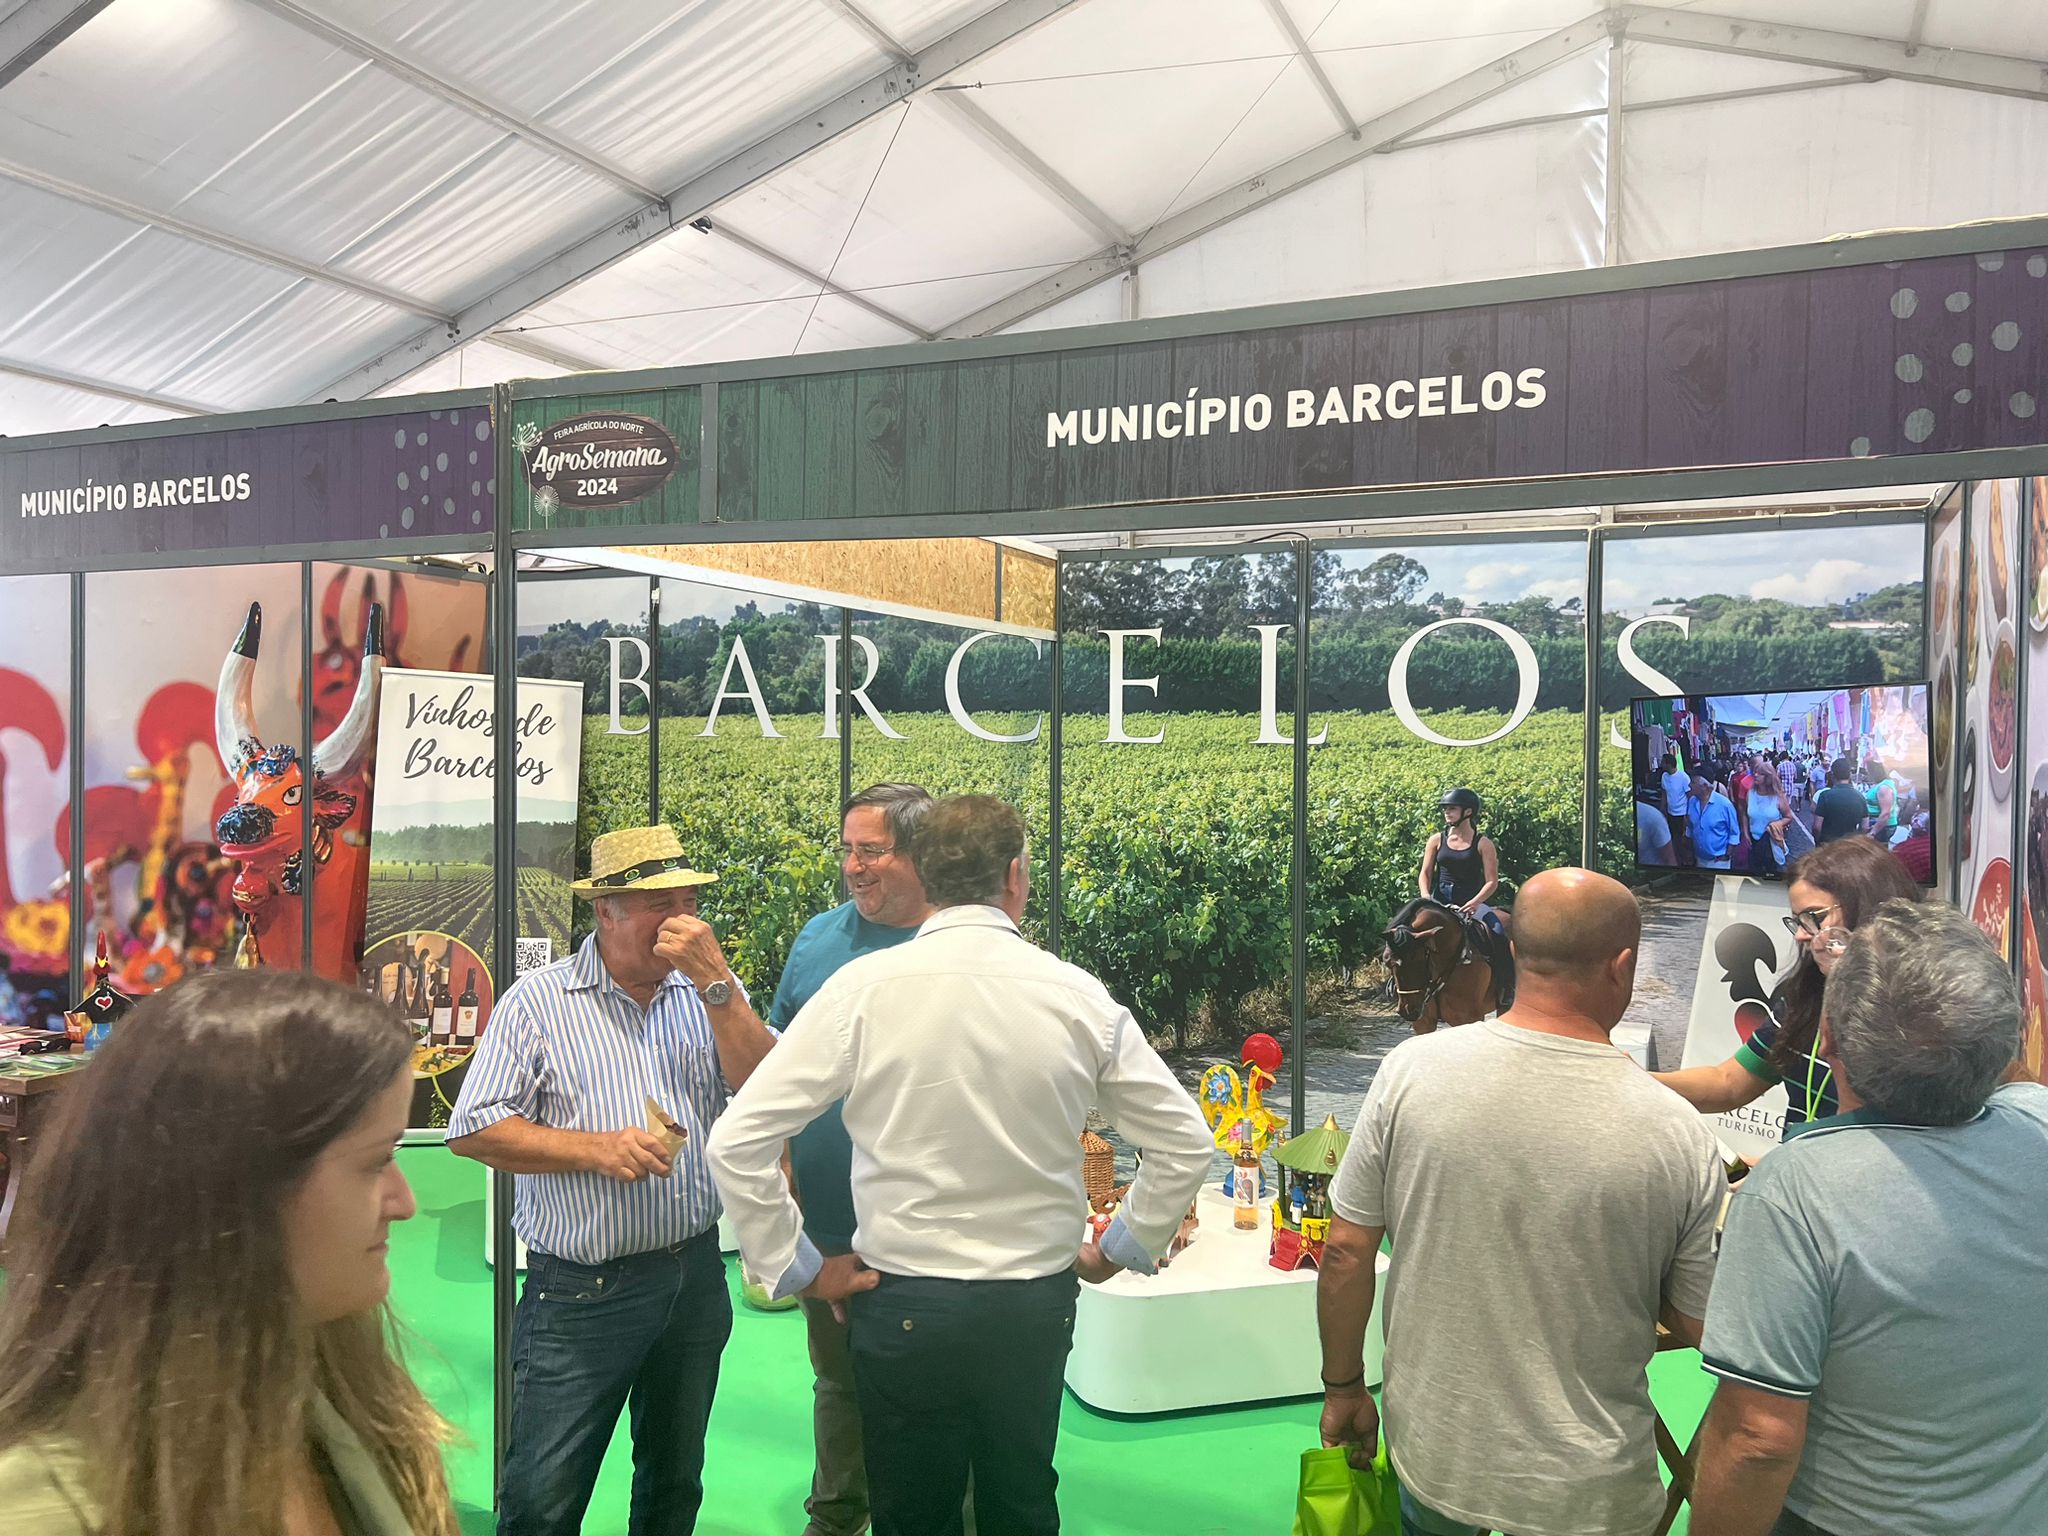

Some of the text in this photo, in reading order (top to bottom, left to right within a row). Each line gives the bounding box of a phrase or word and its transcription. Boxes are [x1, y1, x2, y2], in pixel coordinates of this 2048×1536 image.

[1046, 367, 1547, 448] MUNICÍPIO BARCELOS
[553, 420, 645, 441] FEIRA AGRÍCOLA DO NORTE
[531, 442, 668, 482] AgroSemana
[21, 472, 251, 518] MUNICÍPIO BARCELOS
[577, 477, 618, 497] 2024
[516, 703, 557, 738] de
[403, 737, 554, 786] Barceos
[1716, 1116, 1776, 1140] TURISMO
